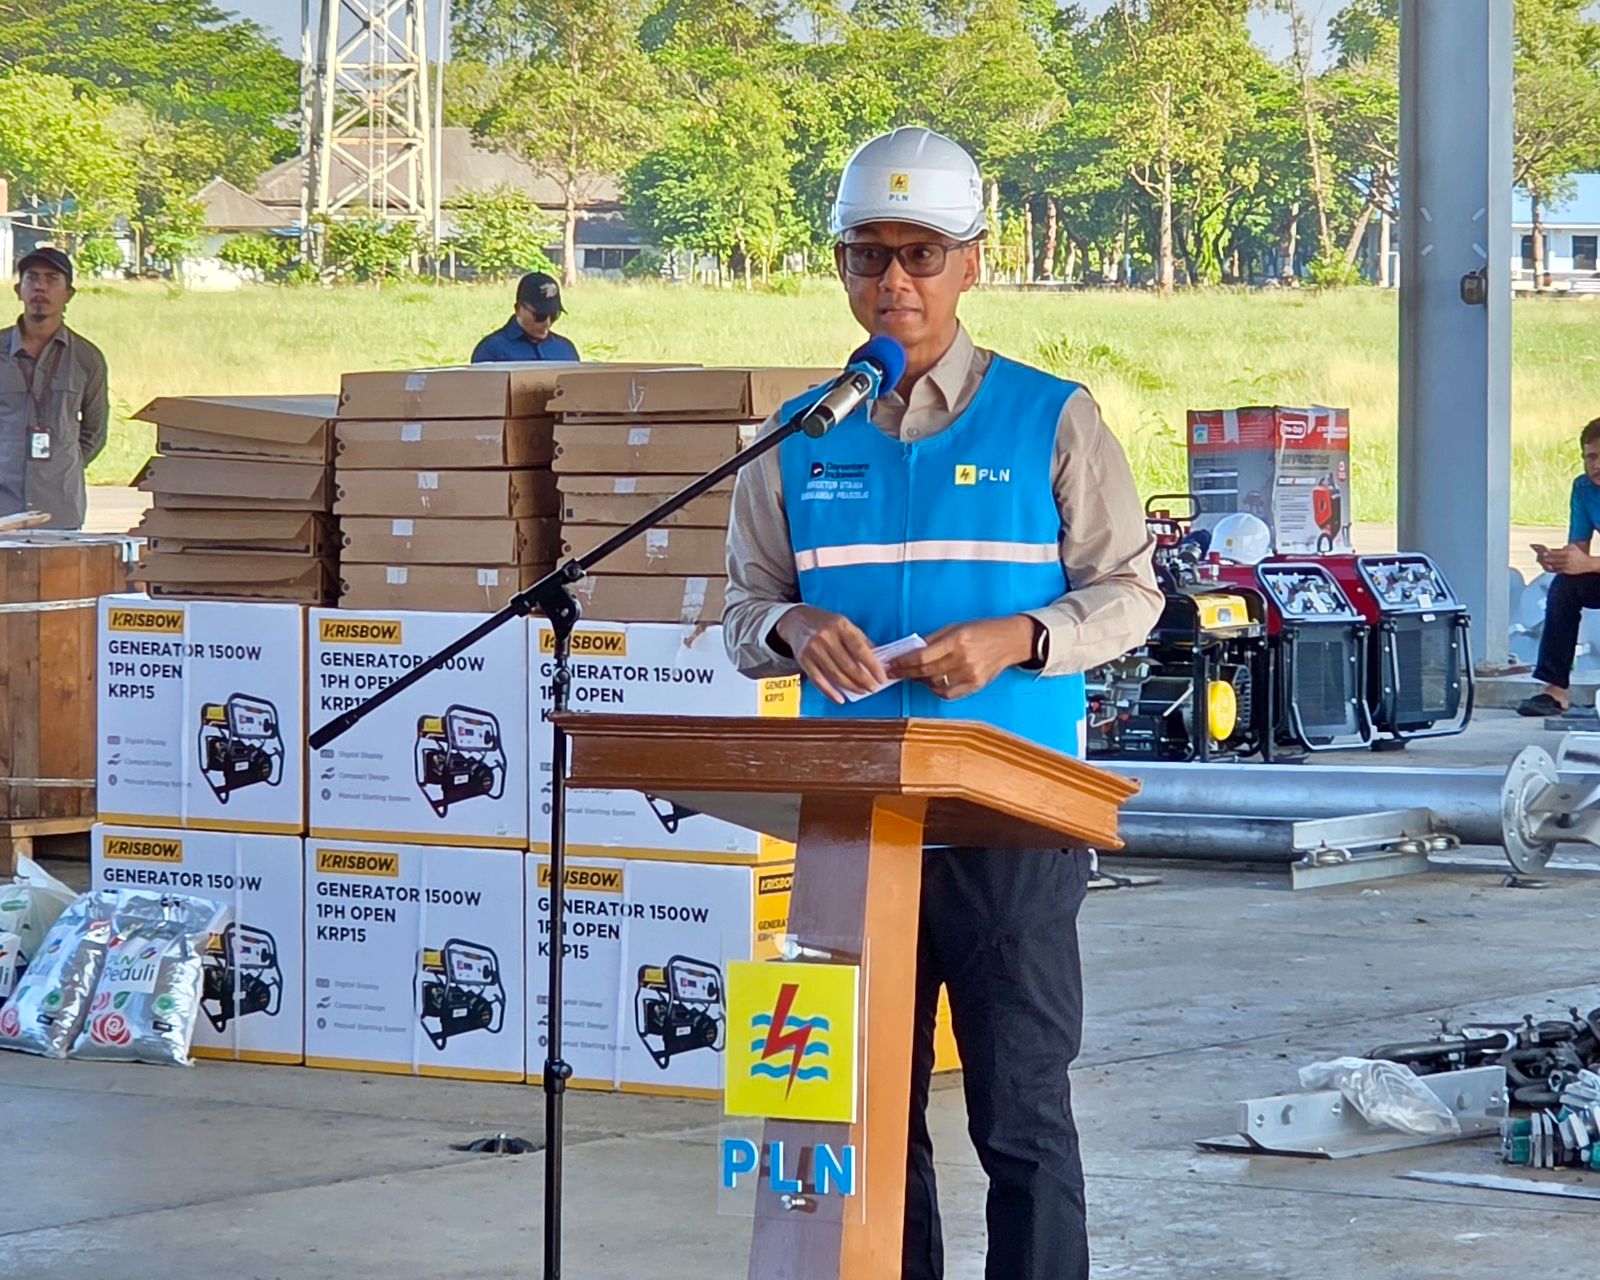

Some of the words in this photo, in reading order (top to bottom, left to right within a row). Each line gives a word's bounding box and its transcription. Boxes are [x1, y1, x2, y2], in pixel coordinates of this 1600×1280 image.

[978, 468, 1010, 482] PLN
[112, 612, 182, 628] KRISBOW
[323, 622, 398, 640] KRISBOW
[108, 640, 205, 659] GENERATOR
[208, 644, 262, 661] 1500W
[544, 634, 622, 651] KSBOW
[108, 661, 136, 677] 1PH
[140, 663, 183, 679] OPEN
[428, 655, 485, 672] 00W
[320, 674, 350, 689] 1PH
[540, 662, 649, 681] GERATOR
[653, 667, 714, 684] 1500W
[108, 683, 155, 699] KRP15
[575, 686, 624, 703] OPEN
[107, 840, 179, 857] KRISBOW
[320, 854, 395, 872] KRISBOW
[103, 868, 203, 888] GENERATOR
[207, 874, 262, 891] 1500W
[541, 869, 619, 887] KISBOW
[760, 876, 792, 891] KRISBO
[317, 882, 420, 902] GENERATOR
[425, 889, 481, 906] 1500W
[316, 904, 346, 919] 1PH
[350, 905, 396, 922] OPEN
[537, 897, 645, 918] GNERATOR
[650, 904, 709, 923] 1500W
[573, 922, 620, 940] OPEN
[758, 919, 788, 930] GENERA
[317, 926, 367, 942] KRP15
[538, 942, 589, 960] KP15
[723, 1138, 856, 1196] PLN
